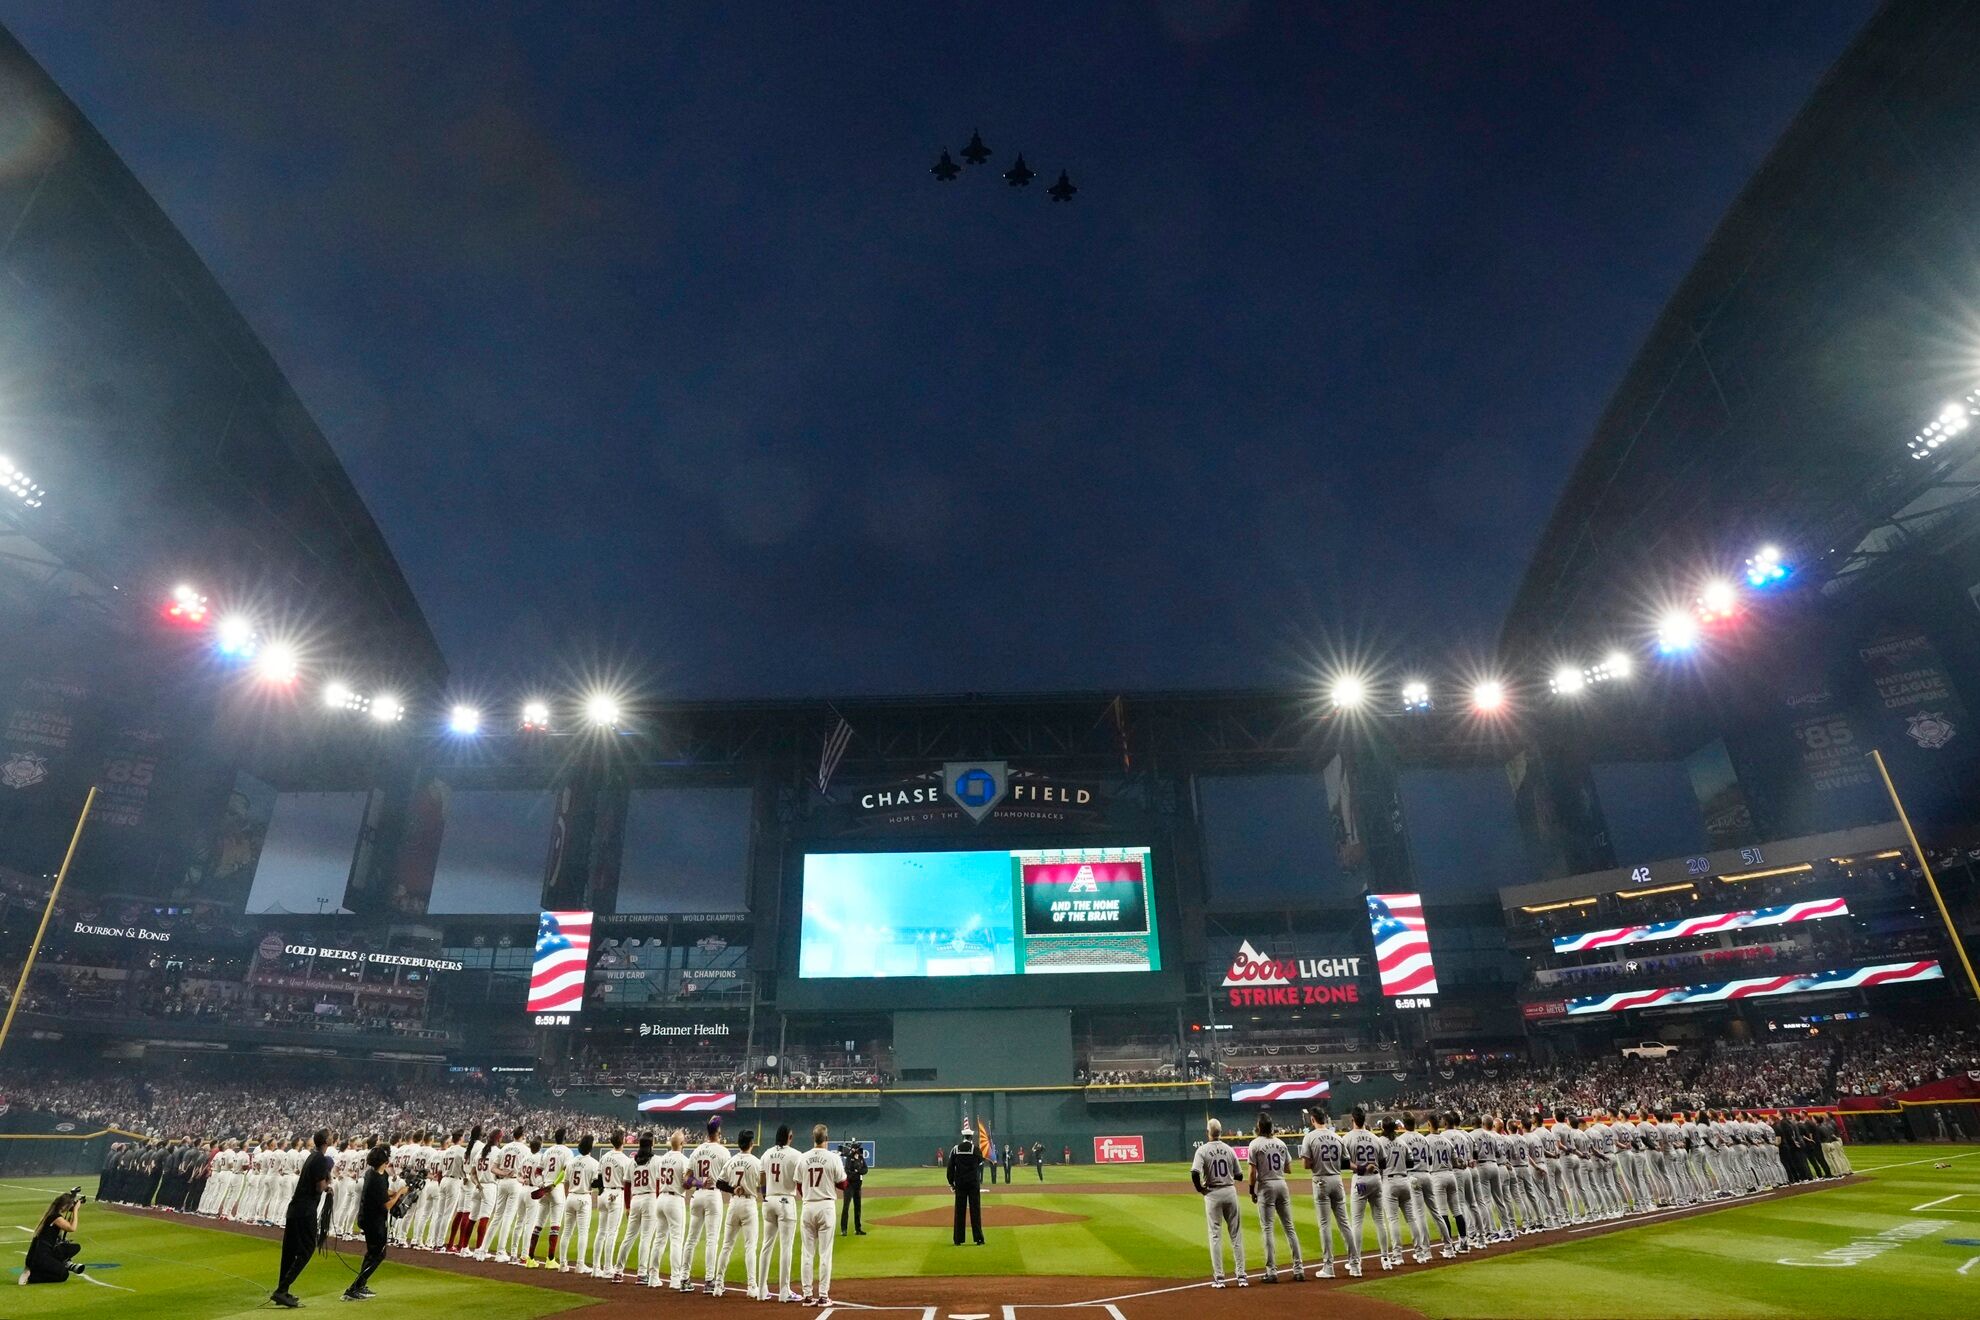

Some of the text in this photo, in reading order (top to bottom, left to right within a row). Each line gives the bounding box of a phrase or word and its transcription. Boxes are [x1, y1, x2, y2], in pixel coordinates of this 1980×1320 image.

[1880, 678, 1945, 700] LEAGUE
[861, 785, 1091, 809] CHASE FIELD
[889, 815, 916, 824] HOME
[993, 811, 1064, 820] DIAMONDBACKS
[1740, 848, 1764, 865] 51
[1686, 857, 1710, 875] 20
[1631, 867, 1652, 882] 42
[1050, 899, 1120, 911] AND THE HOME
[629, 914, 669, 922] CHAMPIONS
[682, 914, 745, 922] WORLD CHAMPIONS
[1052, 911, 1119, 922] OF THE BRAVE
[125, 927, 135, 938] &
[285, 944, 317, 956] COLD
[319, 947, 358, 961] BEERS
[359, 953, 367, 962] &
[368, 953, 464, 971] CHEESEBURGERS
[1227, 951, 1360, 981] Coors LIGHT
[607, 971, 645, 979] WILD CARD
[683, 970, 737, 979] NL CHAMPIONS
[1229, 984, 1359, 1007] STRIKE ZONE
[1395, 998, 1431, 1009] 6:59 PM
[535, 1015, 570, 1025] 6:59 PM
[652, 1023, 729, 1035] Banner Health
[1099, 1139, 1139, 1160] fry's
[1209, 1149, 1227, 1157] BLACK
[1321, 1144, 1339, 1161] 23
[1356, 1145, 1376, 1161] 22
[1412, 1147, 1427, 1162] 24
[1436, 1149, 1449, 1164] 14
[1519, 1147, 1526, 1160] 8
[415, 1159, 426, 1170] 38
[443, 1157, 454, 1170] 47
[477, 1157, 489, 1171] 65
[504, 1154, 516, 1168] 81
[549, 1157, 556, 1172] 2
[1267, 1153, 1281, 1171] 19
[1392, 1151, 1400, 1167] 7
[604, 1167, 612, 1183] 9
[697, 1160, 710, 1177] 12
[771, 1163, 781, 1182] 4
[1212, 1159, 1228, 1177] 10
[573, 1170, 581, 1186] 5
[634, 1169, 649, 1187] 28
[660, 1168, 674, 1185] 53
[735, 1171, 744, 1186] 7
[807, 1167, 824, 1187] 17
